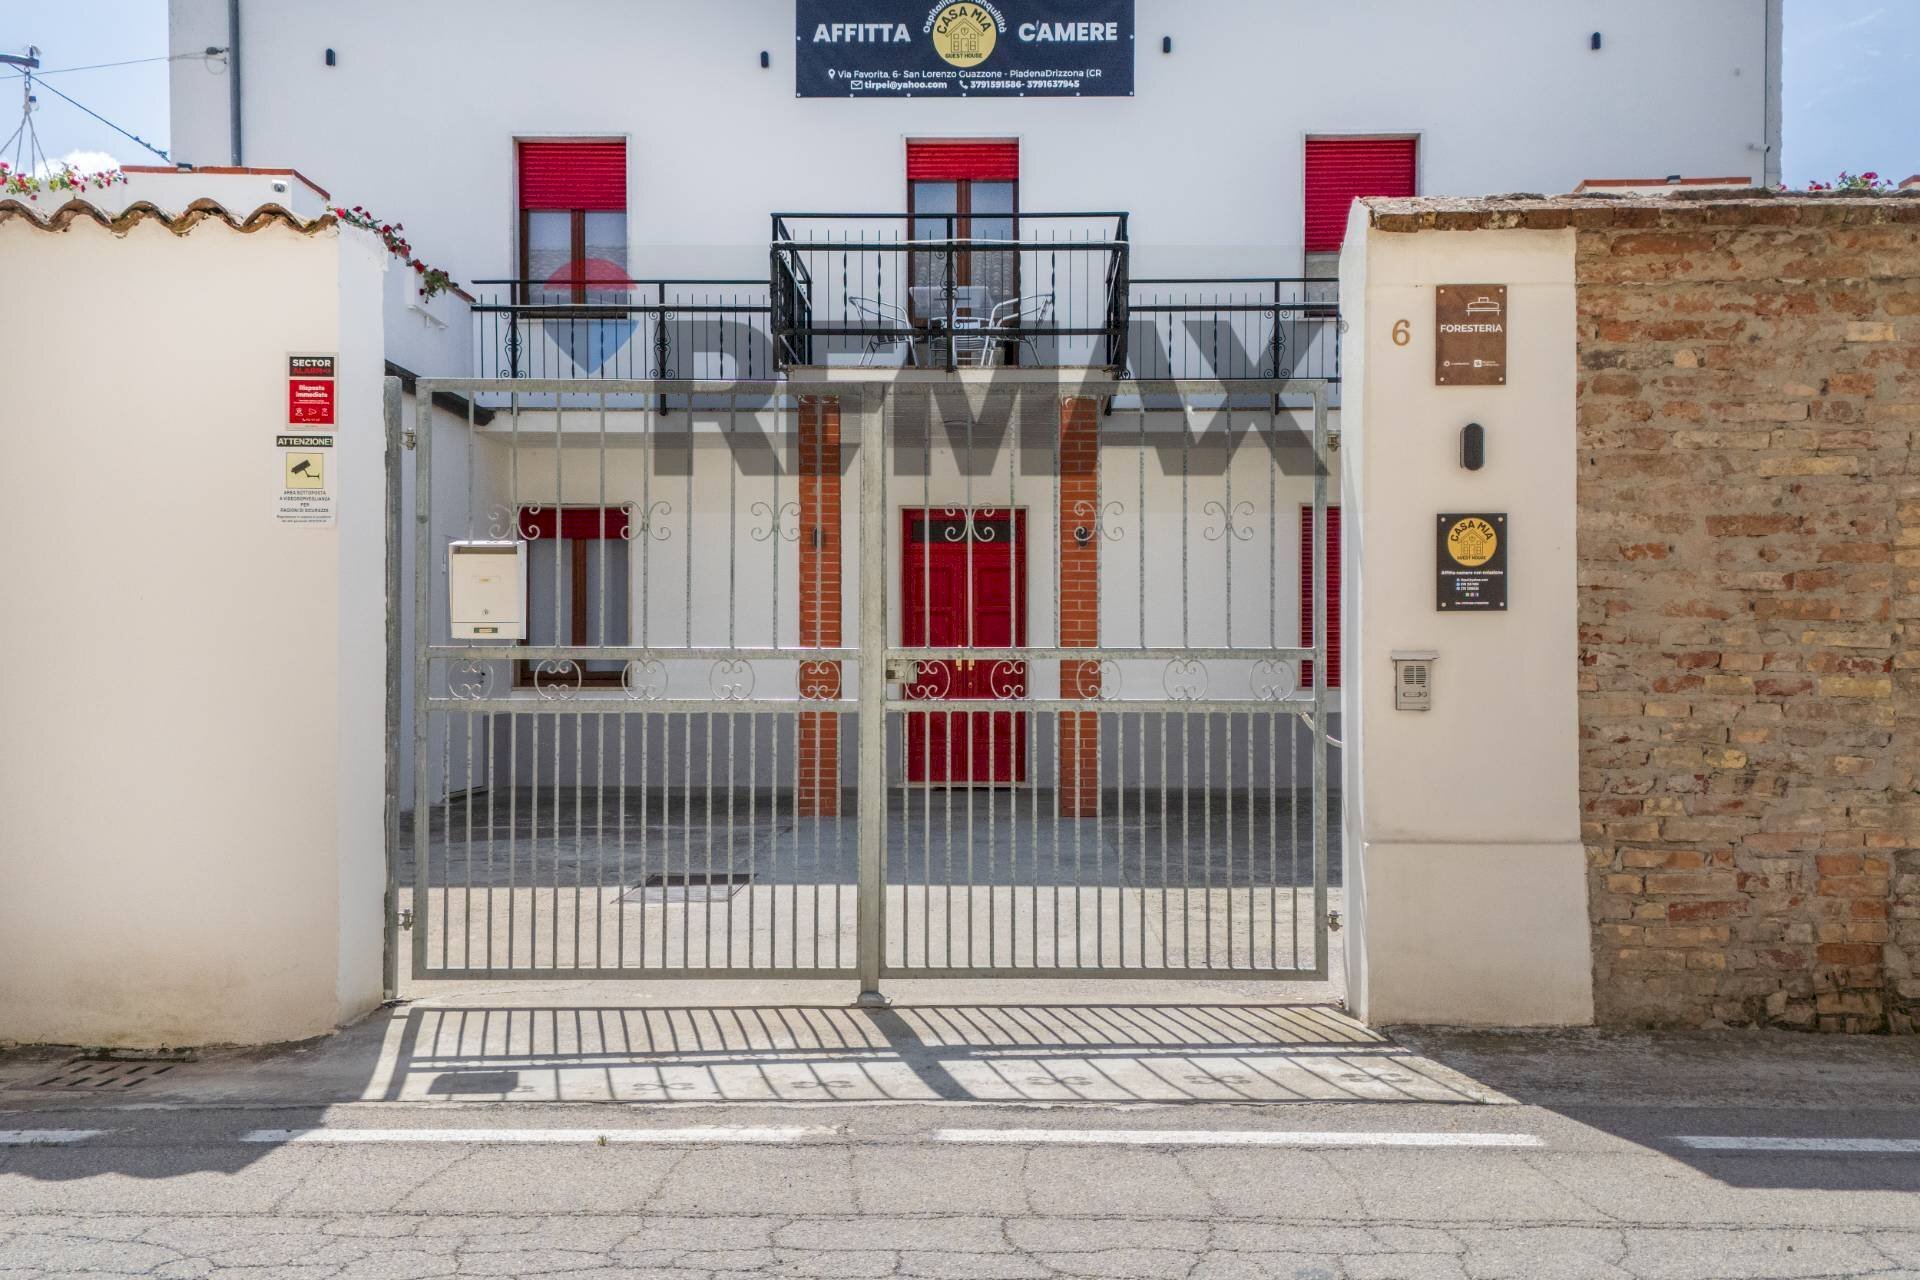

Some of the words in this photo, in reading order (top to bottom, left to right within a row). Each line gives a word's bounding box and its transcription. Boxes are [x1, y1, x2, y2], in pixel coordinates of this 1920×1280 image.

[936, 6, 968, 35] CASA
[970, 8, 992, 33] MIA
[812, 23, 912, 43] AFFITTA
[837, 70, 852, 78] Via
[903, 70, 920, 78] San
[922, 70, 957, 78] Lorenzo
[958, 70, 1003, 78] Guazzone
[1392, 318, 1410, 346] 6
[1440, 324, 1503, 333] FORESTERIA
[292, 359, 331, 367] SECTOR
[277, 437, 333, 446] ATTENZIONE!
[1450, 520, 1475, 542] CASA
[1477, 522, 1494, 541] MIA
